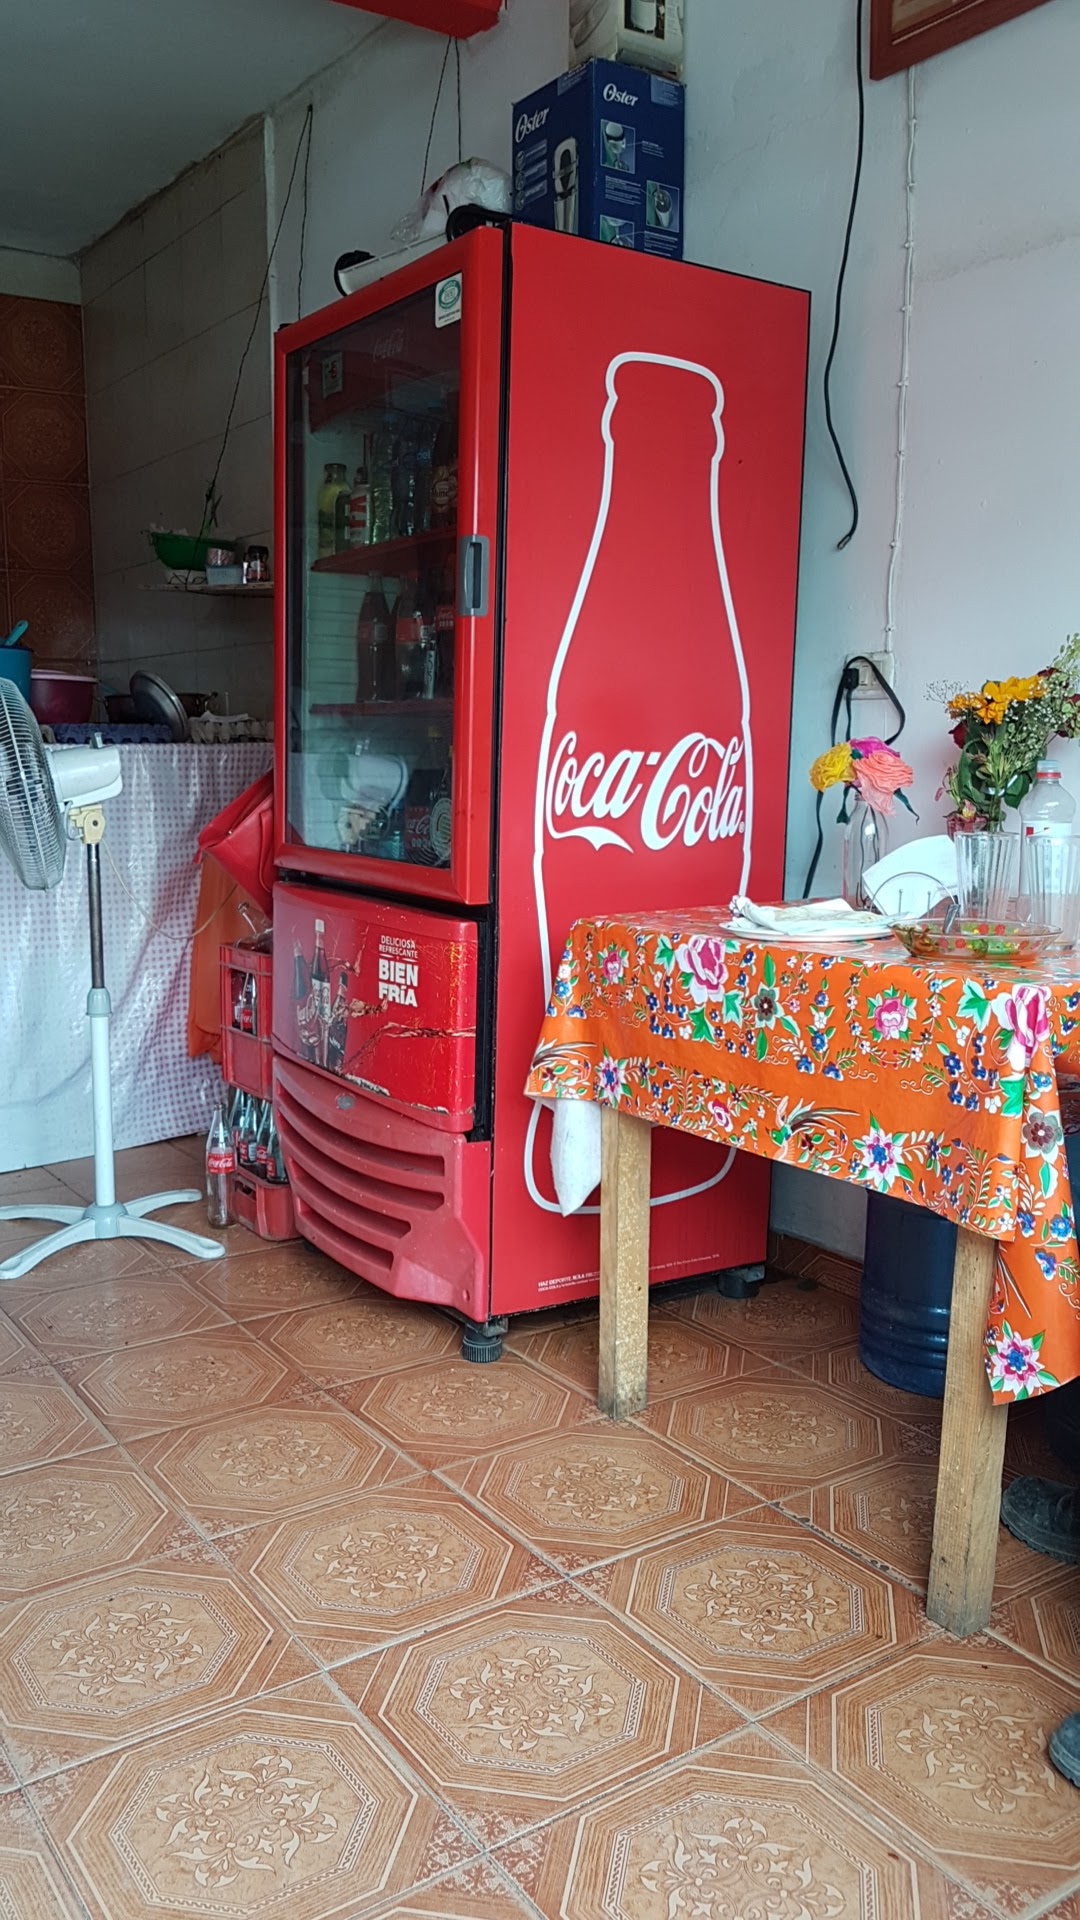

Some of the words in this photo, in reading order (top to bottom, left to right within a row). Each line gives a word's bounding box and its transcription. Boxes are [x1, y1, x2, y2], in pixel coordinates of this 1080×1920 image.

[603, 83, 638, 107] Oster
[515, 108, 549, 143] Oster
[546, 731, 743, 853] Coca-Cola
[379, 944, 419, 958] REFRESCANTE
[381, 935, 416, 950] DELICIOSA
[378, 958, 419, 987] BIEN
[378, 981, 418, 1008] FRÍA
